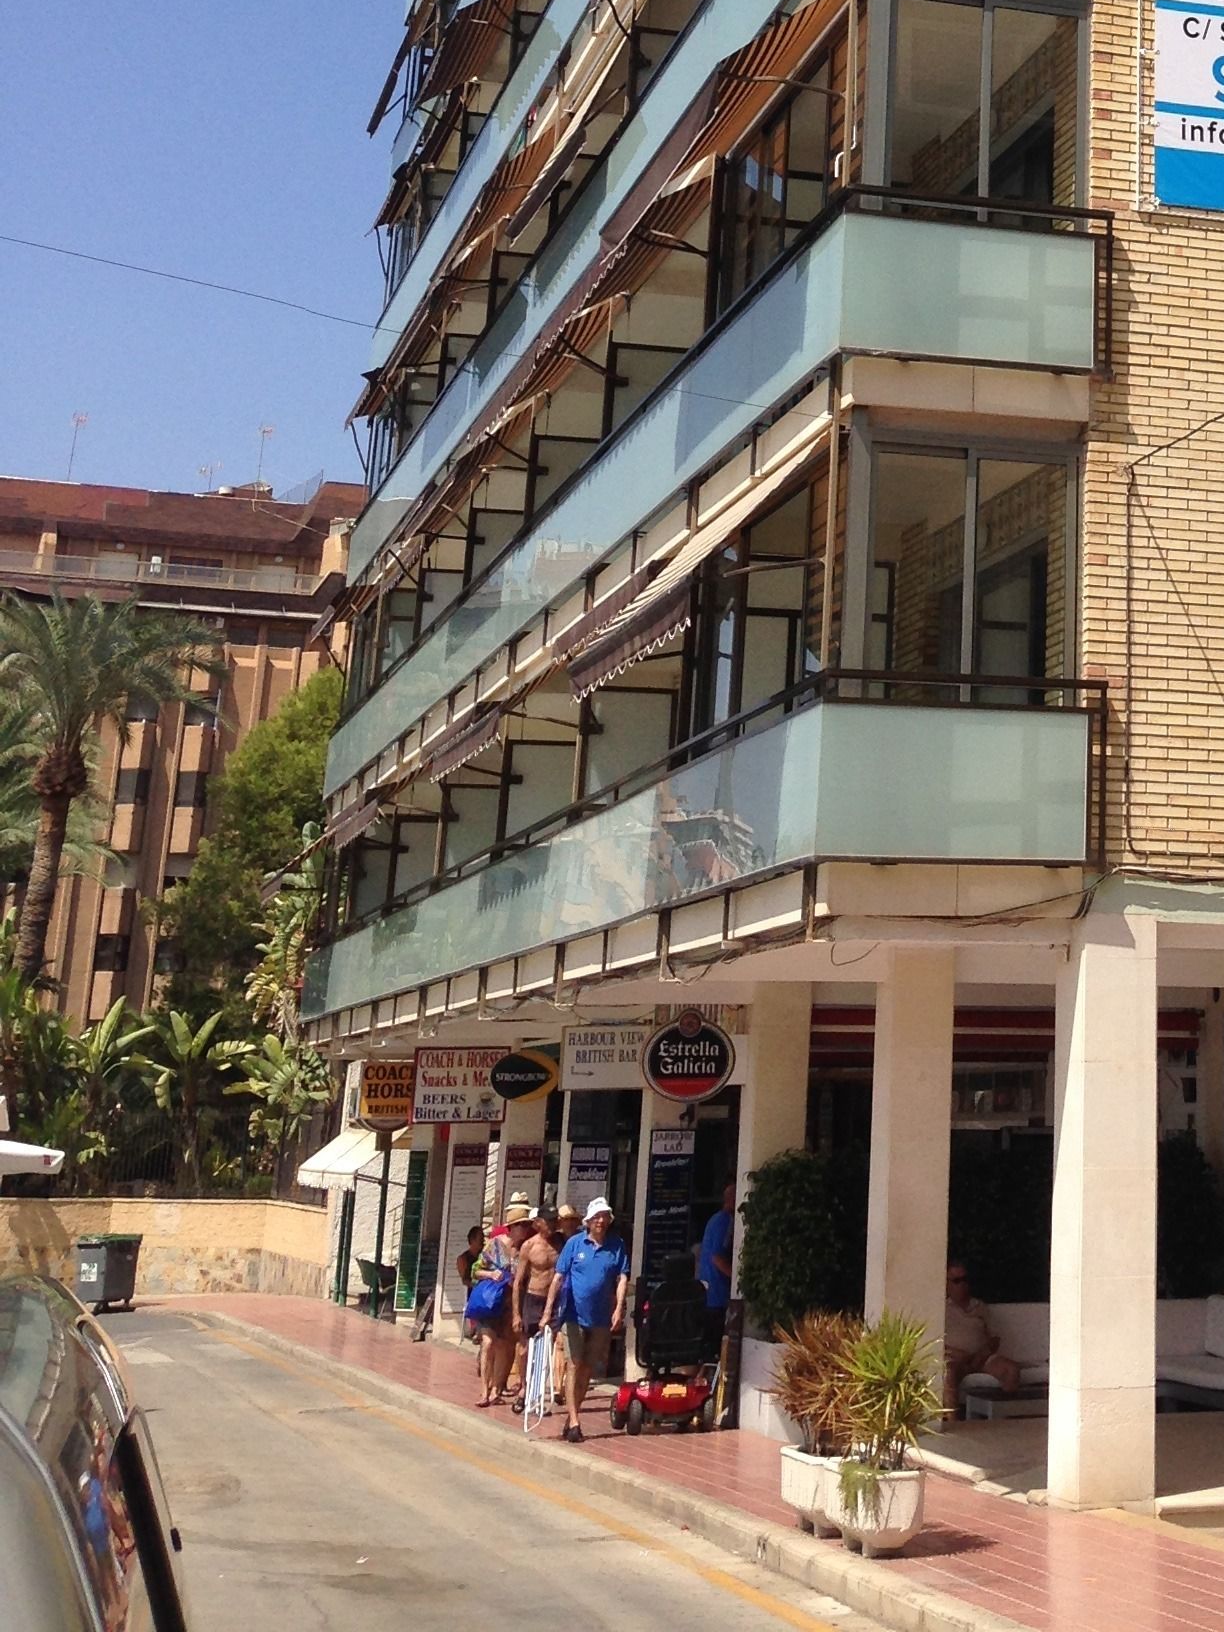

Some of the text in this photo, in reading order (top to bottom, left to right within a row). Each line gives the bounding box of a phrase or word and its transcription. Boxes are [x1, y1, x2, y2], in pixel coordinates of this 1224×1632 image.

[1182, 16, 1211, 42] C/
[568, 1032, 616, 1046] HARBOUR
[576, 1048, 637, 1063] BRITISH BAR
[658, 1040, 719, 1057] Estrella
[420, 1051, 454, 1069] COACH
[660, 1057, 716, 1075] Galicia
[420, 1071, 458, 1087] Snacks
[423, 1093, 466, 1105] BEERS
[415, 1106, 501, 1120] Bitter & Lager
